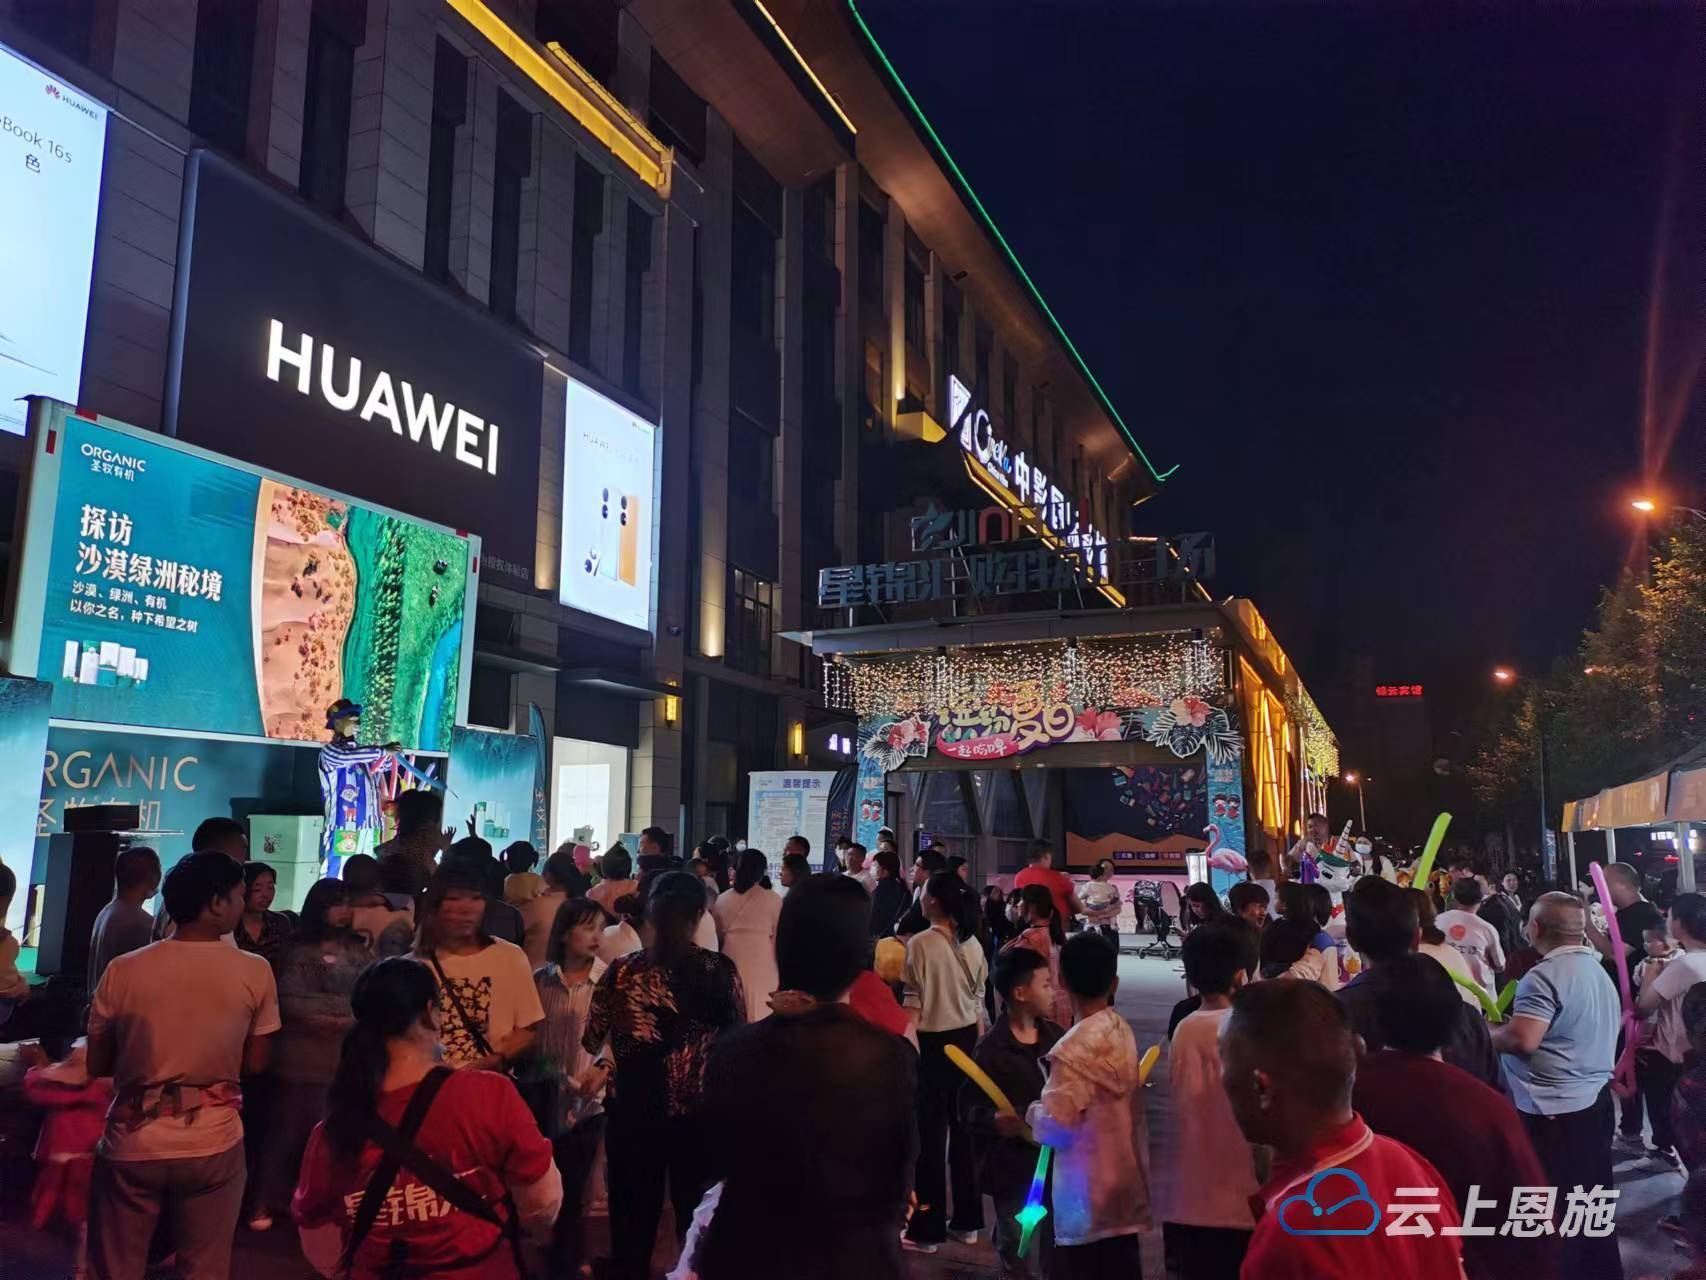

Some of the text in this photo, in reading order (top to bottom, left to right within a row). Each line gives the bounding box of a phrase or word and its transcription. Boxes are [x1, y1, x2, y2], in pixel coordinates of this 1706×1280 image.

[62, 95, 98, 120] HUAWEI
[0, 115, 72, 163] Book 16s
[25, 153, 41, 174] 色
[266, 318, 499, 476] HUAWEI
[81, 443, 147, 473] ORGANIC
[91, 459, 135, 483] 圣牧有机
[80, 504, 133, 547] 探访
[75, 542, 223, 602] 沙漠绿洲秘境
[72, 580, 168, 611] 沙漠、绿洲、有机
[70, 599, 198, 634] 以你之名，种下希望之树
[36, 796, 161, 837] 圣机
